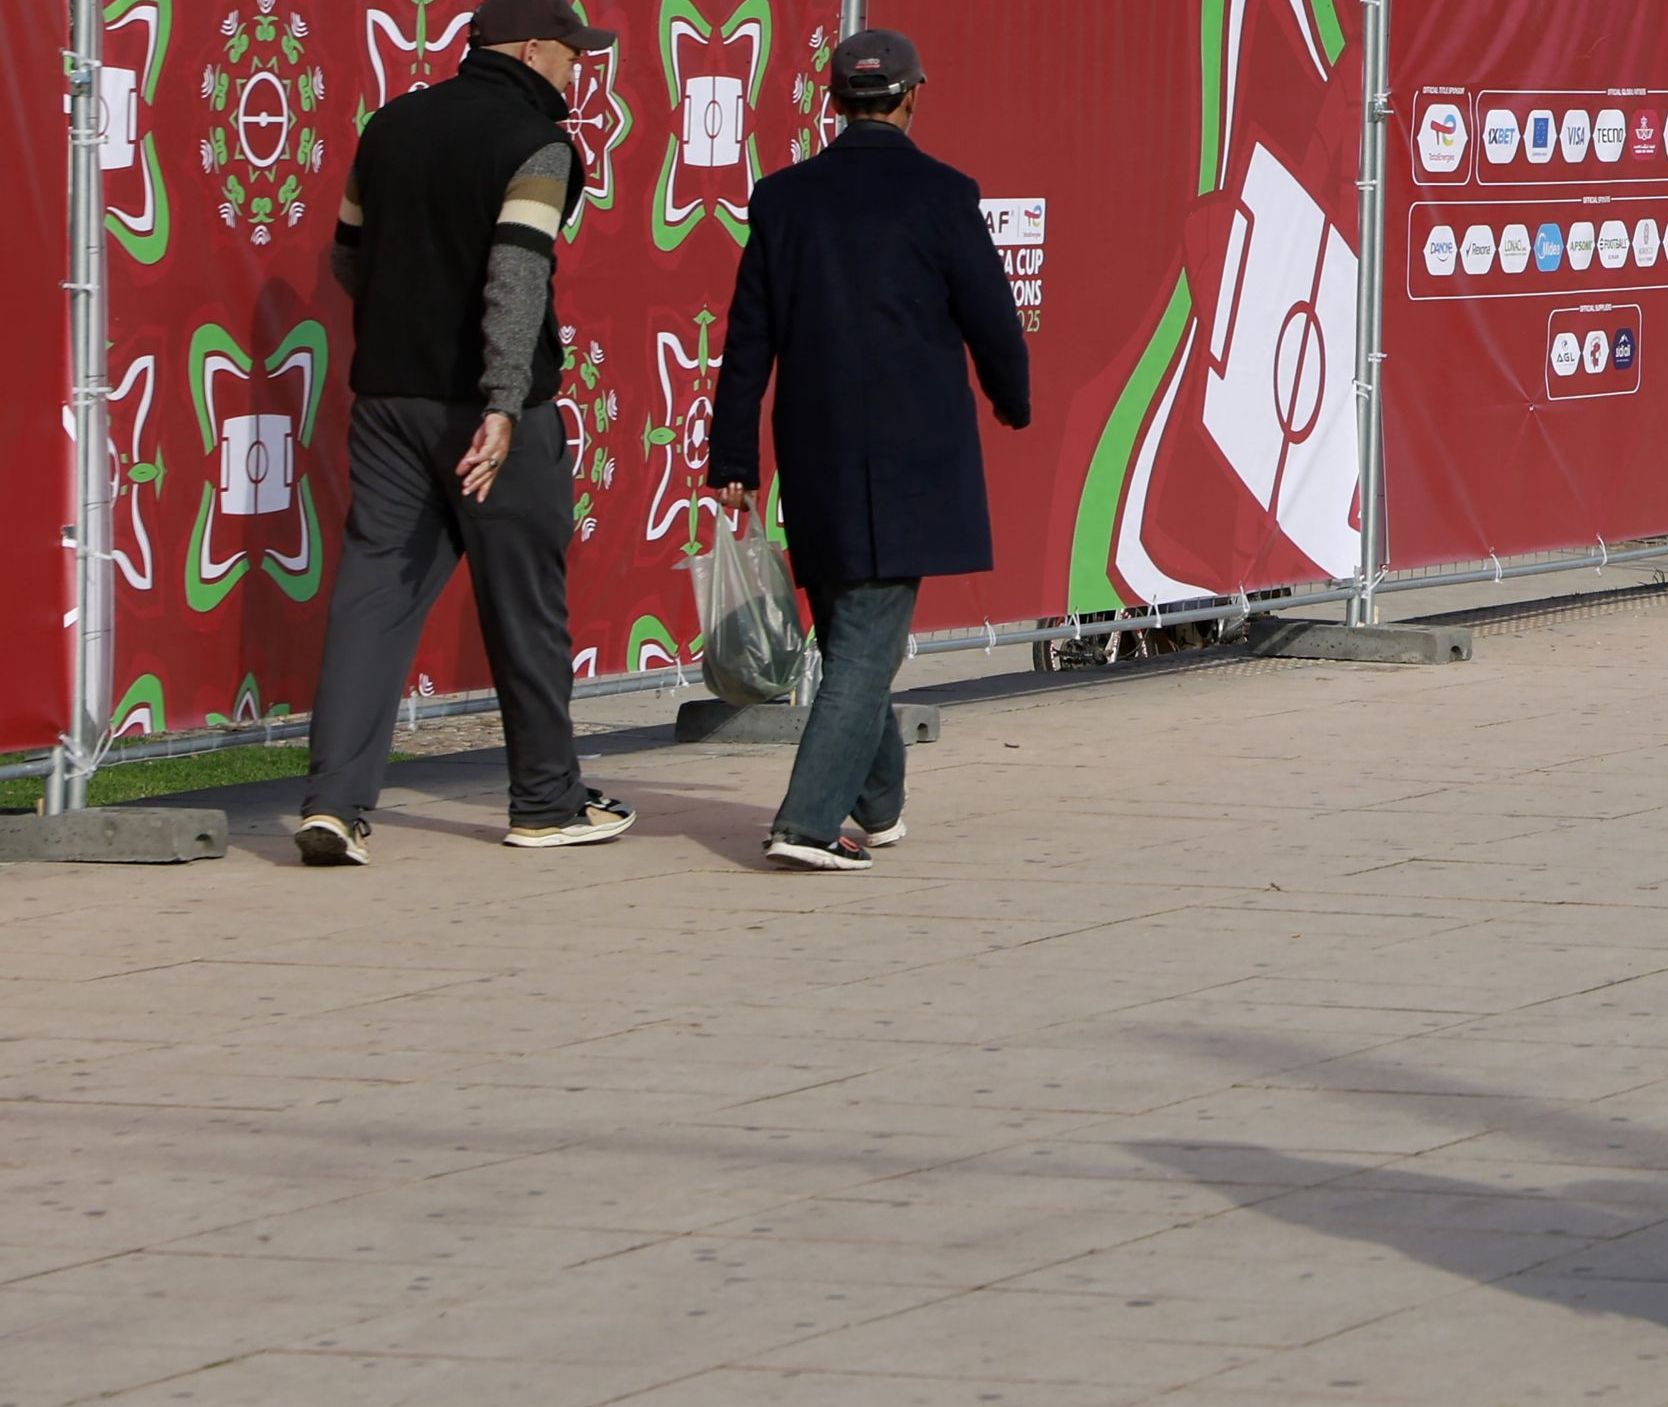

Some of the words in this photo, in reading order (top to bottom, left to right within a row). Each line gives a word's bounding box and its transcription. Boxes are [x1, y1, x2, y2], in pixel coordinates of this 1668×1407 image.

[1567, 127, 1585, 145] VISA
[1597, 127, 1624, 143] TECNO
[985, 211, 1009, 234] AF
[1471, 242, 1491, 255] Rexona
[1016, 248, 1044, 276] CUP
[1557, 353, 1575, 363] AGL
